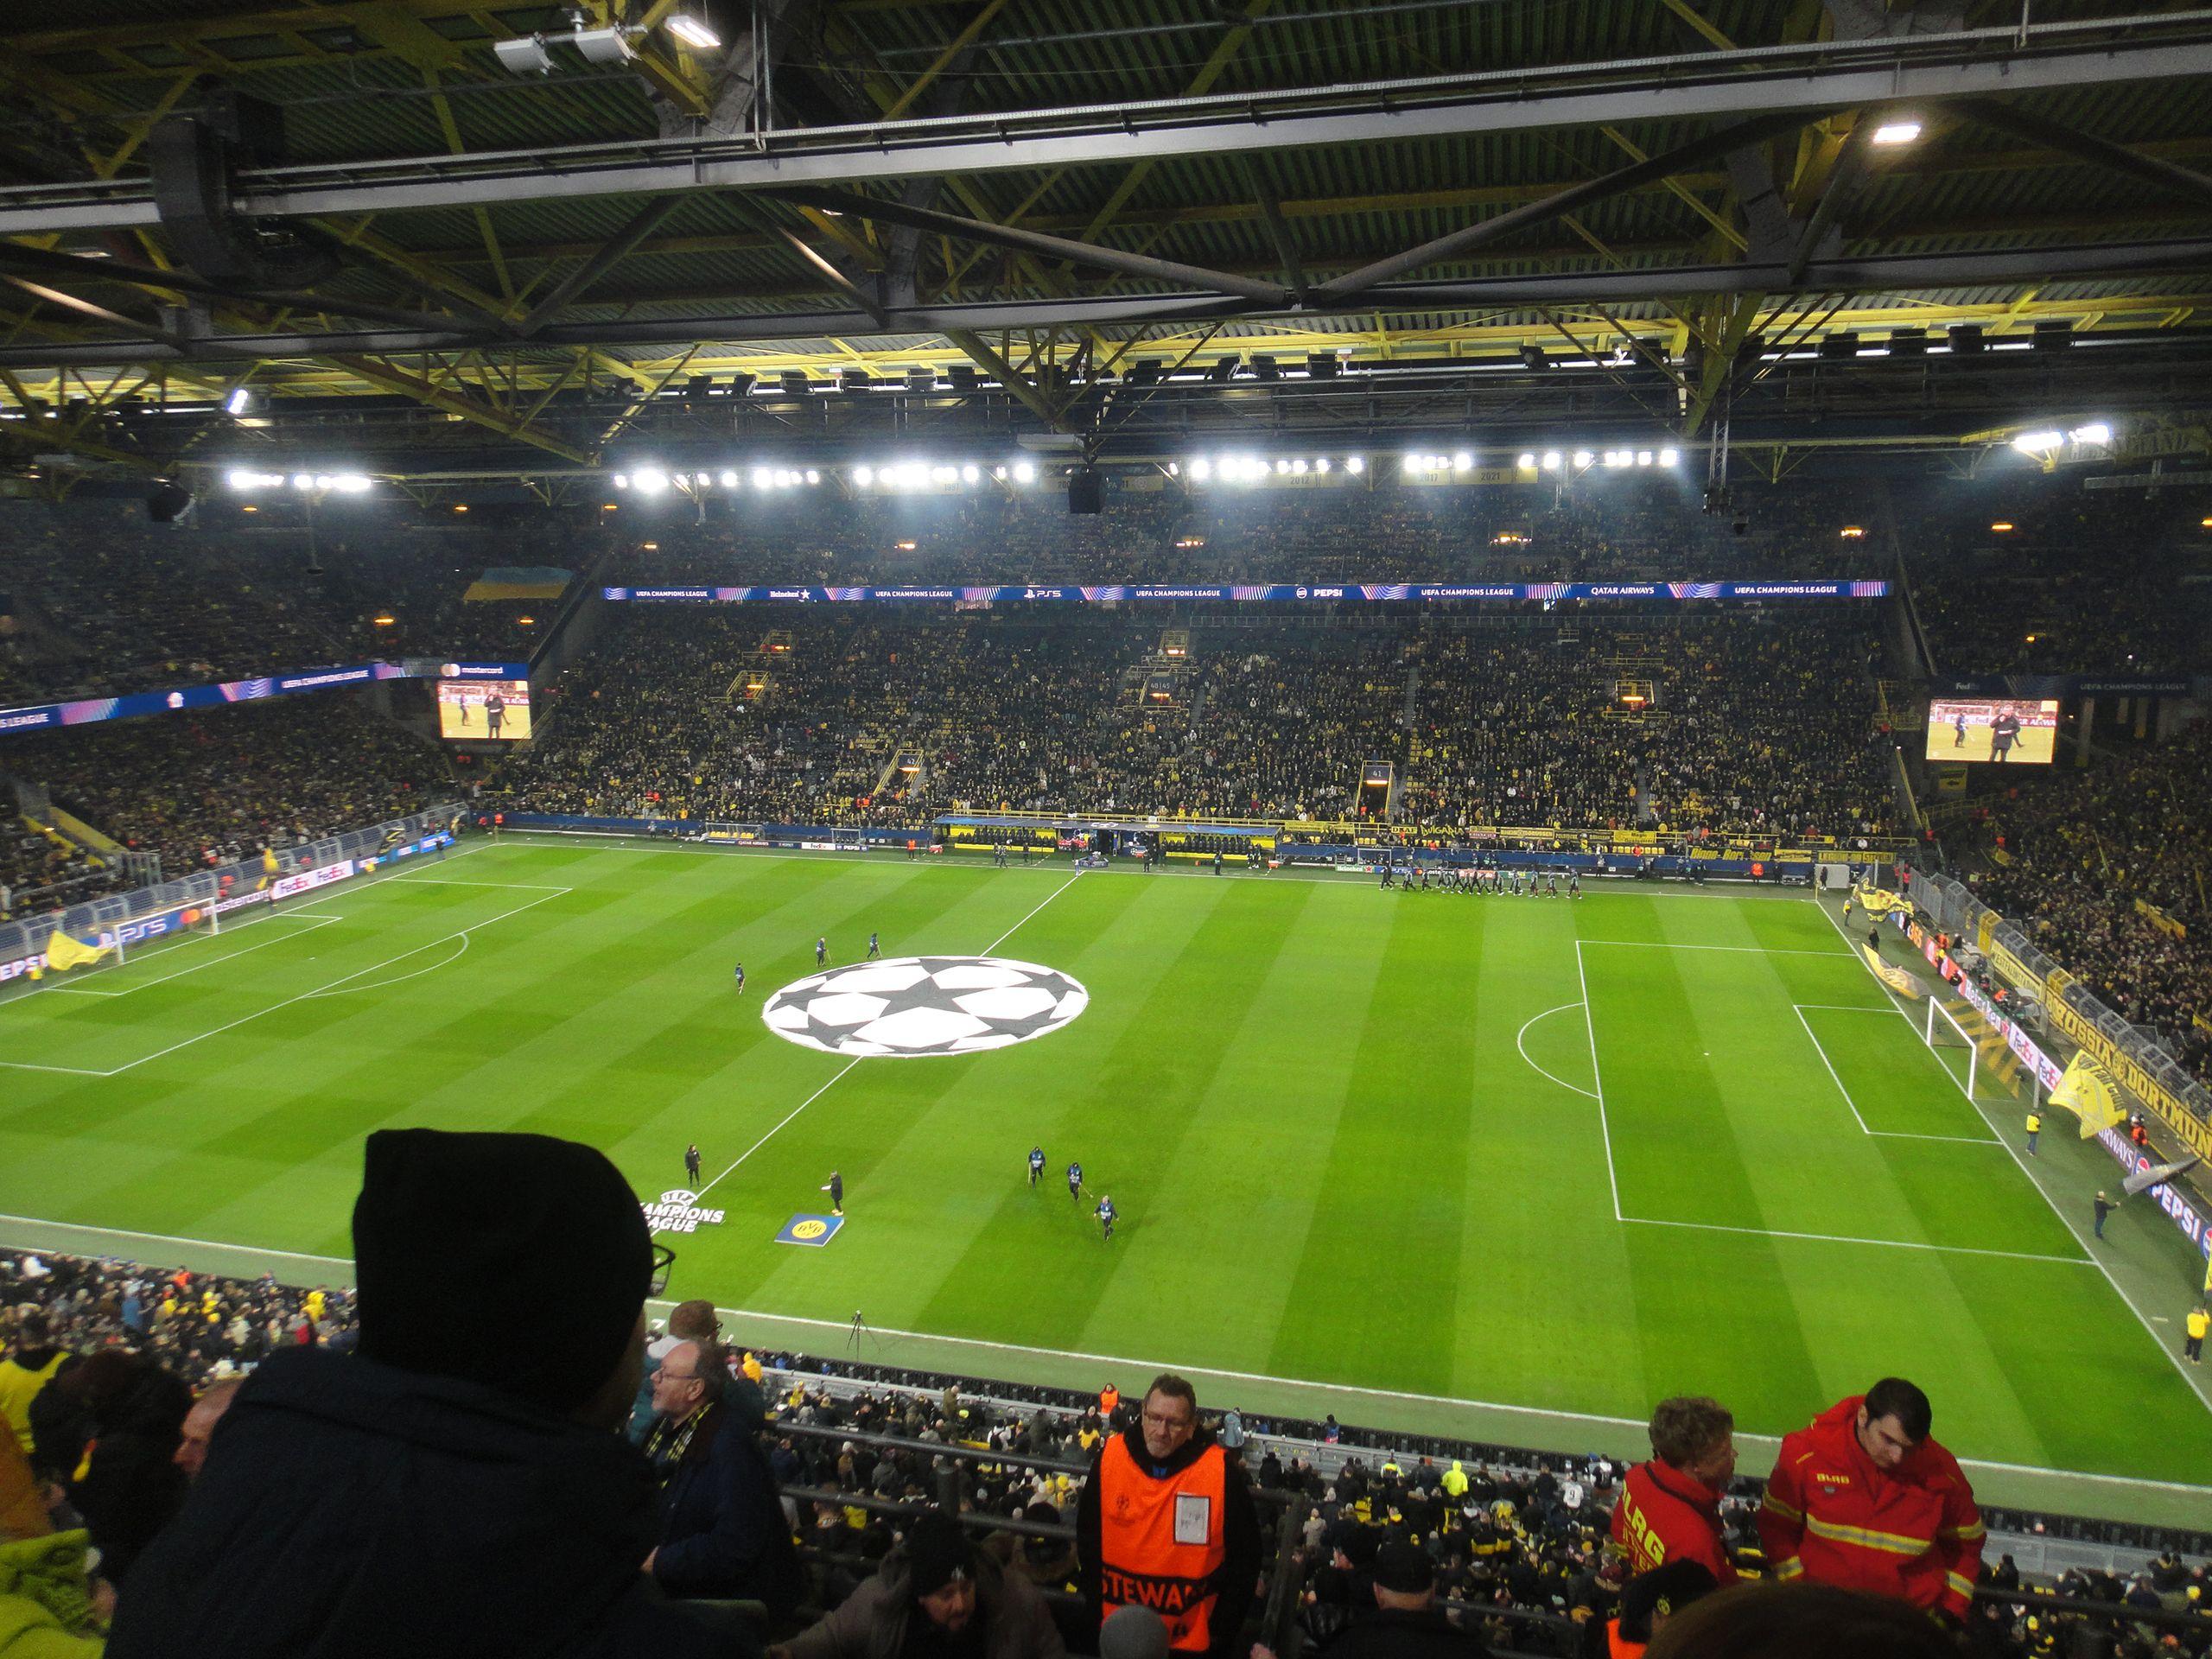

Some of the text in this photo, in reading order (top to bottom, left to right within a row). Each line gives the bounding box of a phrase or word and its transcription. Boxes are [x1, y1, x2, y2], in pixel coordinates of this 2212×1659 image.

[1591, 587, 1618, 596] QATAR
[1757, 586, 1805, 594] CHAMPIONS
[7, 713, 49, 727] LEAGUE
[280, 874, 310, 894] FedEx
[316, 866, 346, 885] FedEx
[120, 918, 167, 944] PS5
[2099, 1128, 2134, 1169] RWAYS
[661, 1192, 695, 1206] UEFA
[640, 1202, 725, 1224] AMPIONS
[645, 1216, 699, 1234] AGUE
[1623, 1478, 1666, 1567] LRG
